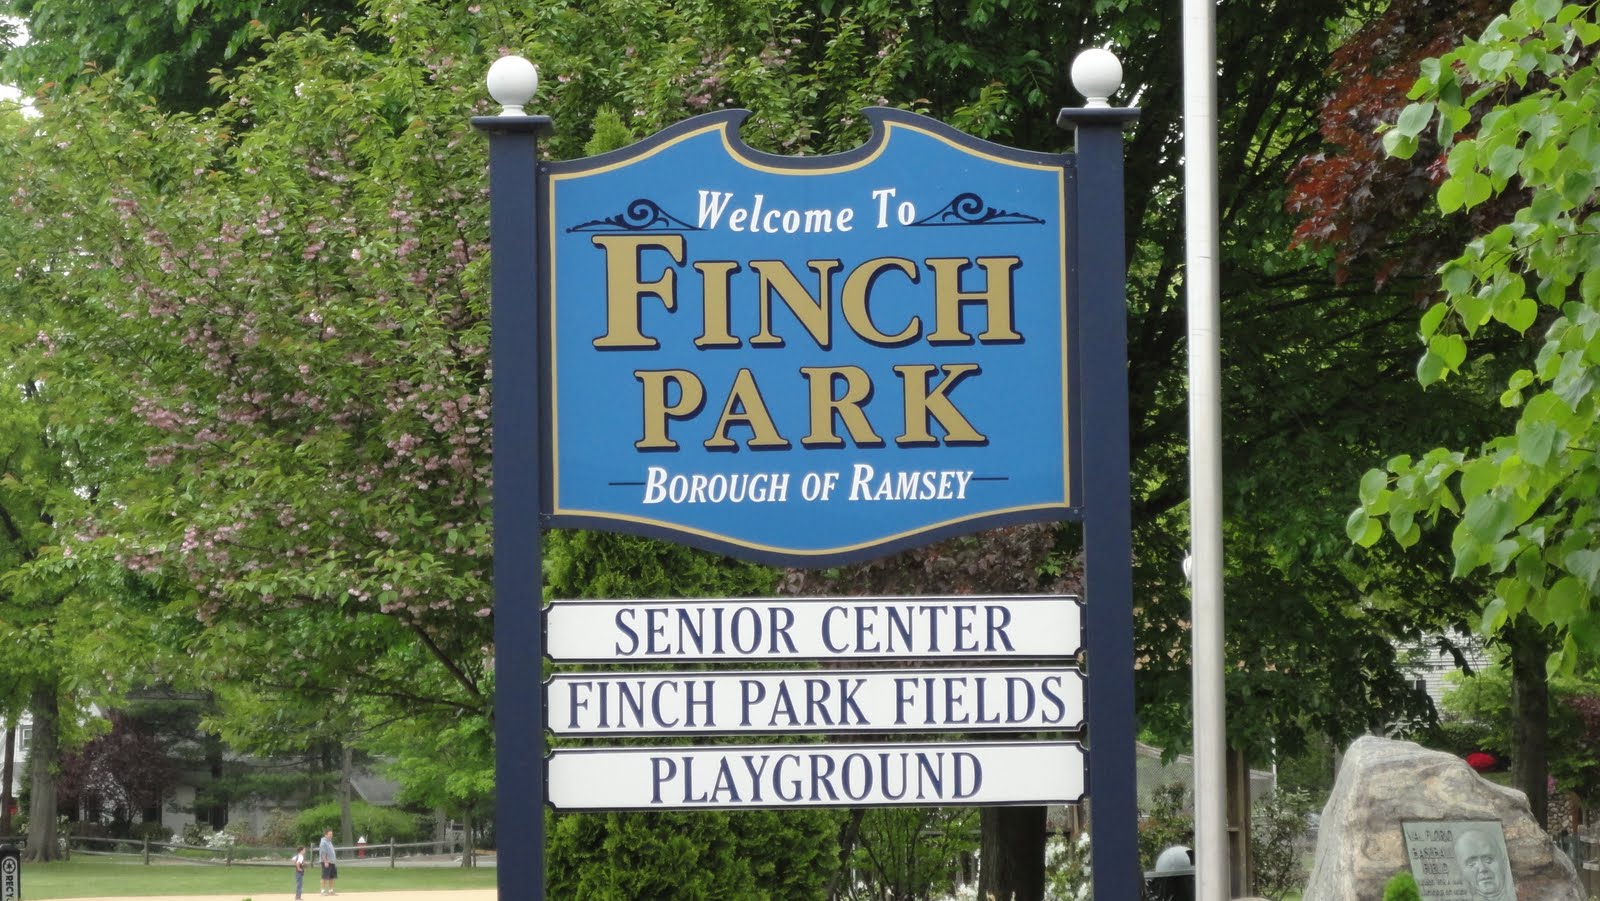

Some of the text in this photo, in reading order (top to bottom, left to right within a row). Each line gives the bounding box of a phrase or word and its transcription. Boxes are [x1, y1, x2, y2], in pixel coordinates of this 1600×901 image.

[697, 187, 916, 234] Welcome To
[591, 233, 1025, 352] FINCH
[633, 363, 990, 452] PARK
[643, 464, 974, 504] BOROUGH OF RAMSEY
[614, 604, 1016, 657] SENIOR CENTER
[567, 675, 1067, 729] FINCH PARK FIELDS
[650, 751, 983, 804] PLAYGROUND
